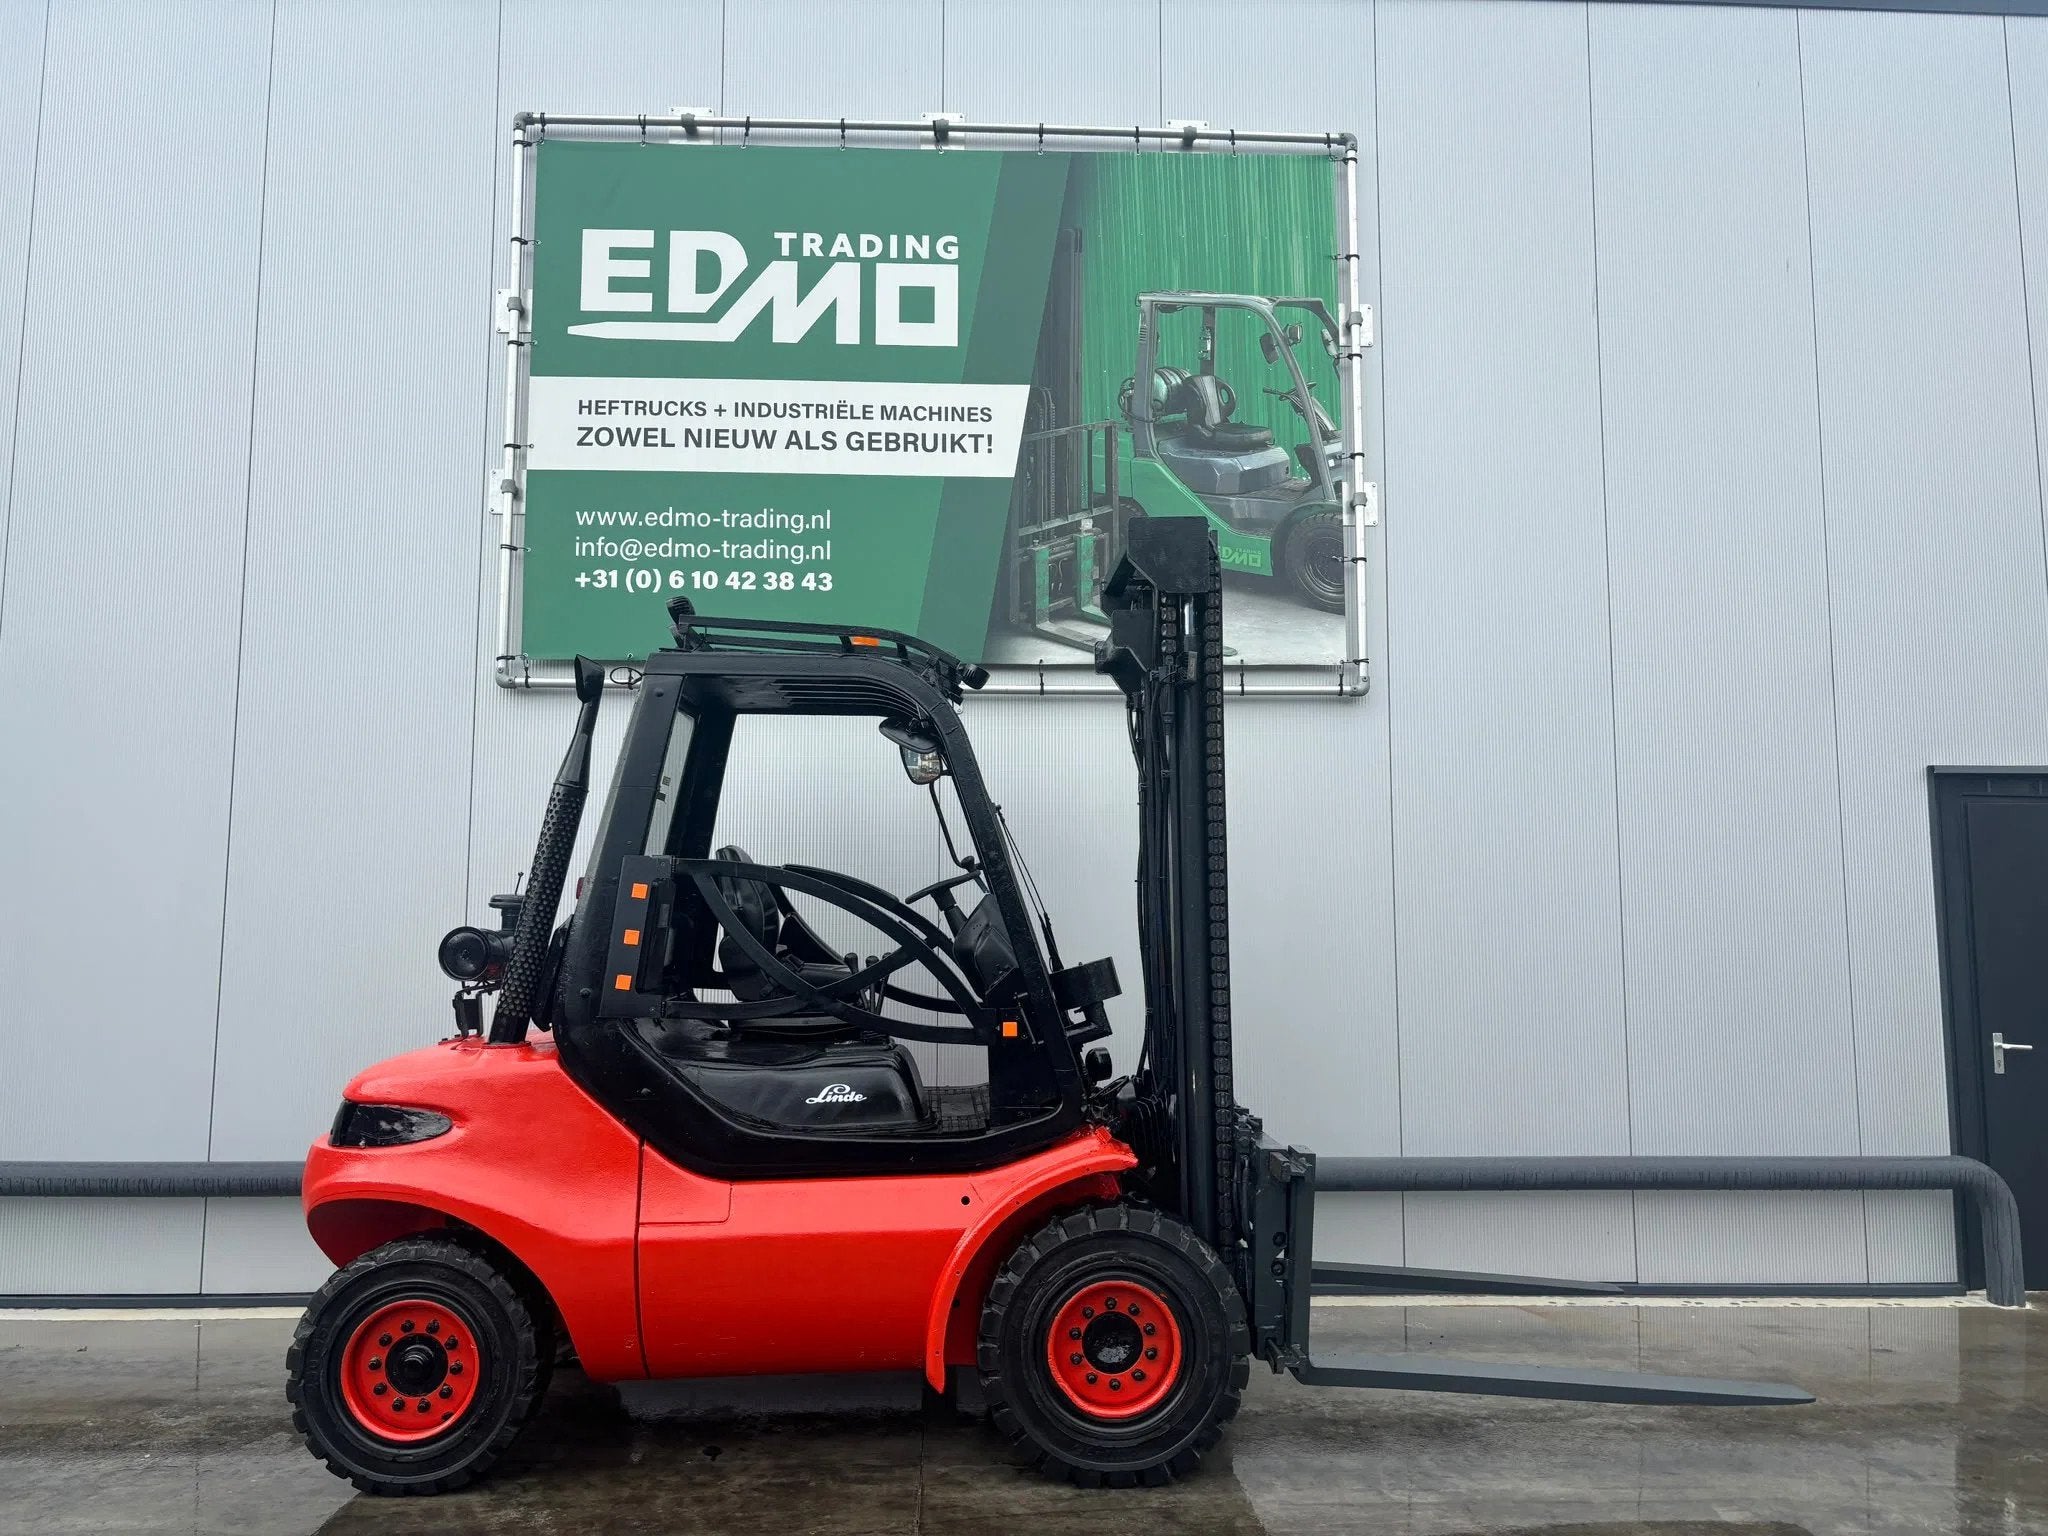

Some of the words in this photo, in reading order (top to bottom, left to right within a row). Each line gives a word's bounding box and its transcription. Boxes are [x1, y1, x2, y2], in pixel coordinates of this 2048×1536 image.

[774, 232, 959, 260] TRADING
[568, 229, 958, 347] EDMO
[578, 399, 707, 417] HEFTRUCKS
[713, 404, 727, 417] +
[734, 398, 874, 420] INDUSTRIËLE
[880, 404, 993, 423] MACHINES
[576, 426, 676, 448] ZOWEL
[684, 427, 778, 450] NIEUW
[784, 429, 838, 451] ALS
[845, 431, 993, 454] GEBRUIKT!
[575, 506, 831, 535] www.edmo-trading.nl
[575, 536, 831, 565] info@edmo-trading.nl
[574, 569, 618, 589] +31
[625, 567, 662, 594] (0)
[668, 569, 685, 589] 6
[691, 570, 719, 590] 10
[724, 571, 757, 590] 42
[762, 571, 795, 591] 38
[801, 572, 833, 592] 43
[805, 1083, 868, 1104] Linde
